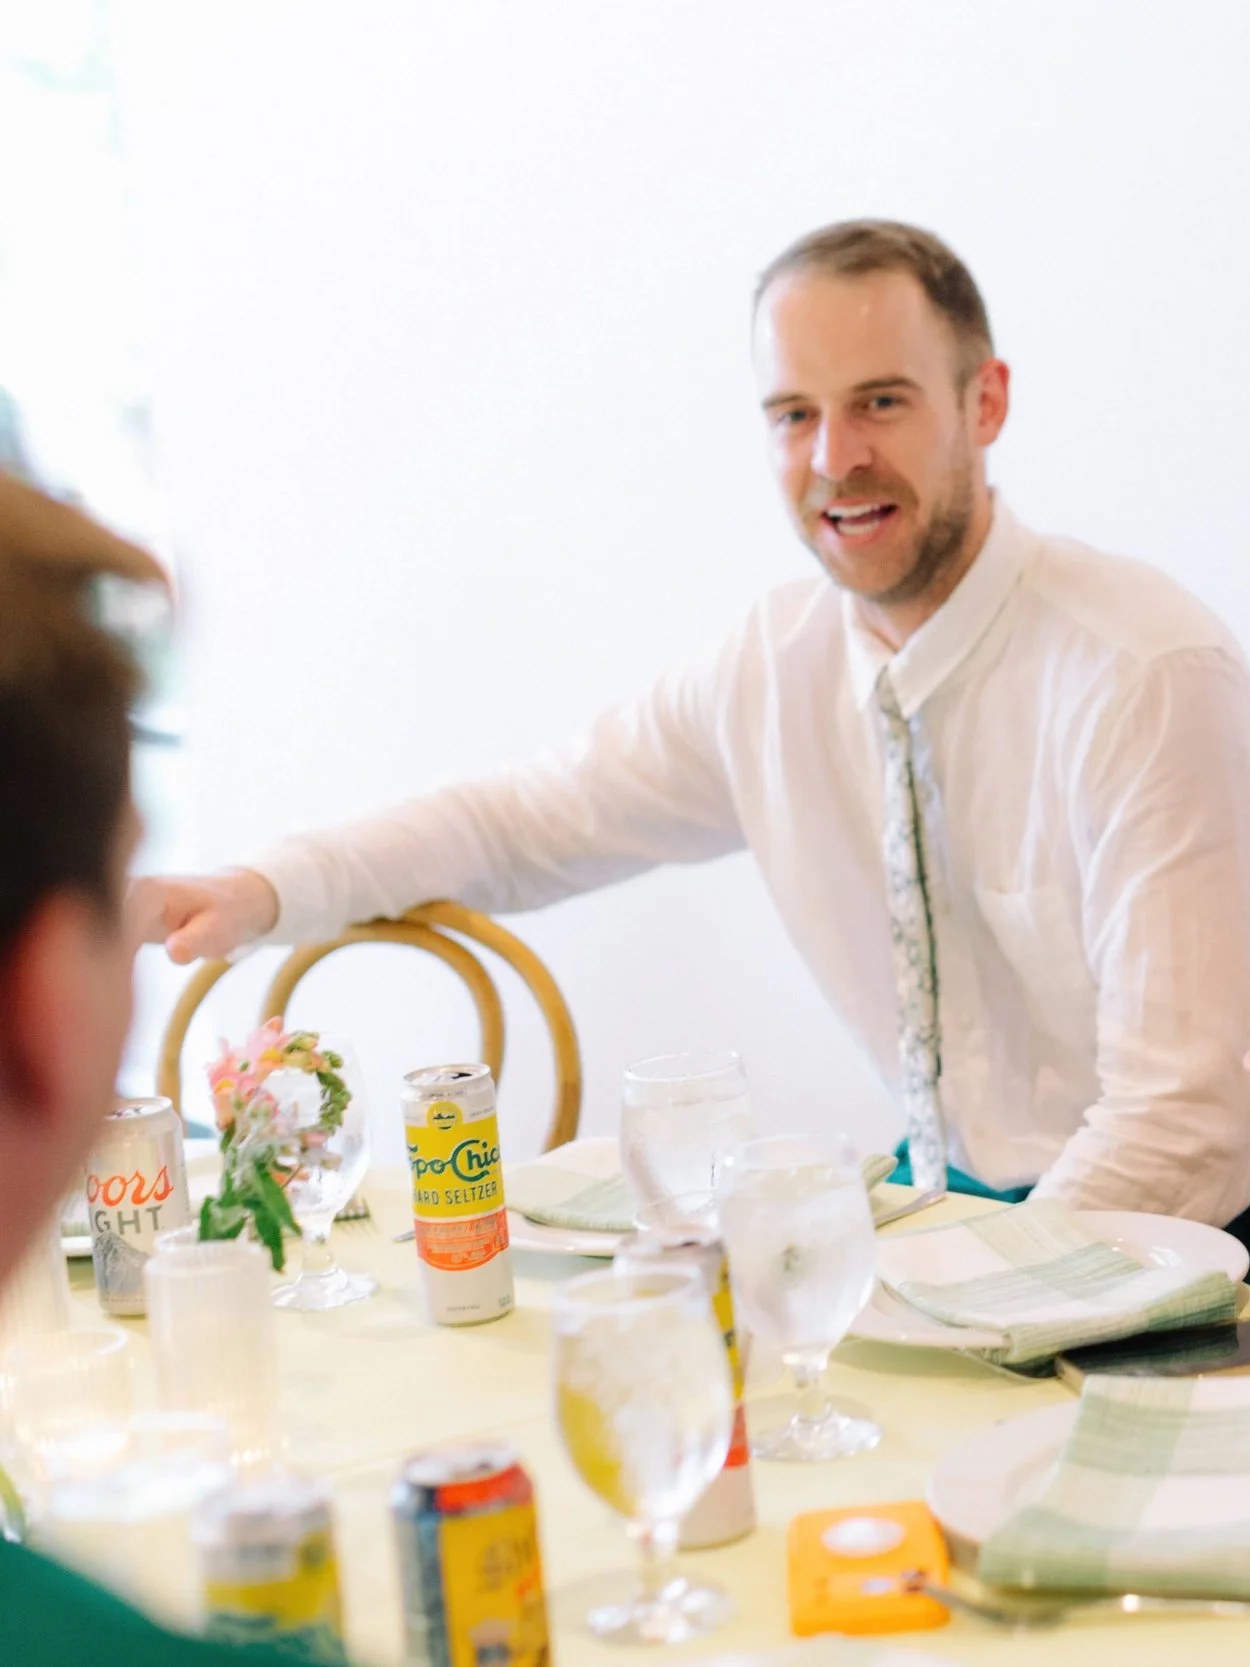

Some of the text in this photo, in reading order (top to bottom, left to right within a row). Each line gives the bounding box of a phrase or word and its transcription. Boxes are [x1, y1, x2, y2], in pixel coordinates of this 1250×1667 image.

[451, 1139, 500, 1182] Chic
[86, 1166, 174, 1207] oors
[445, 1181, 498, 1205] SELTZER
[94, 1205, 162, 1235] GHT
